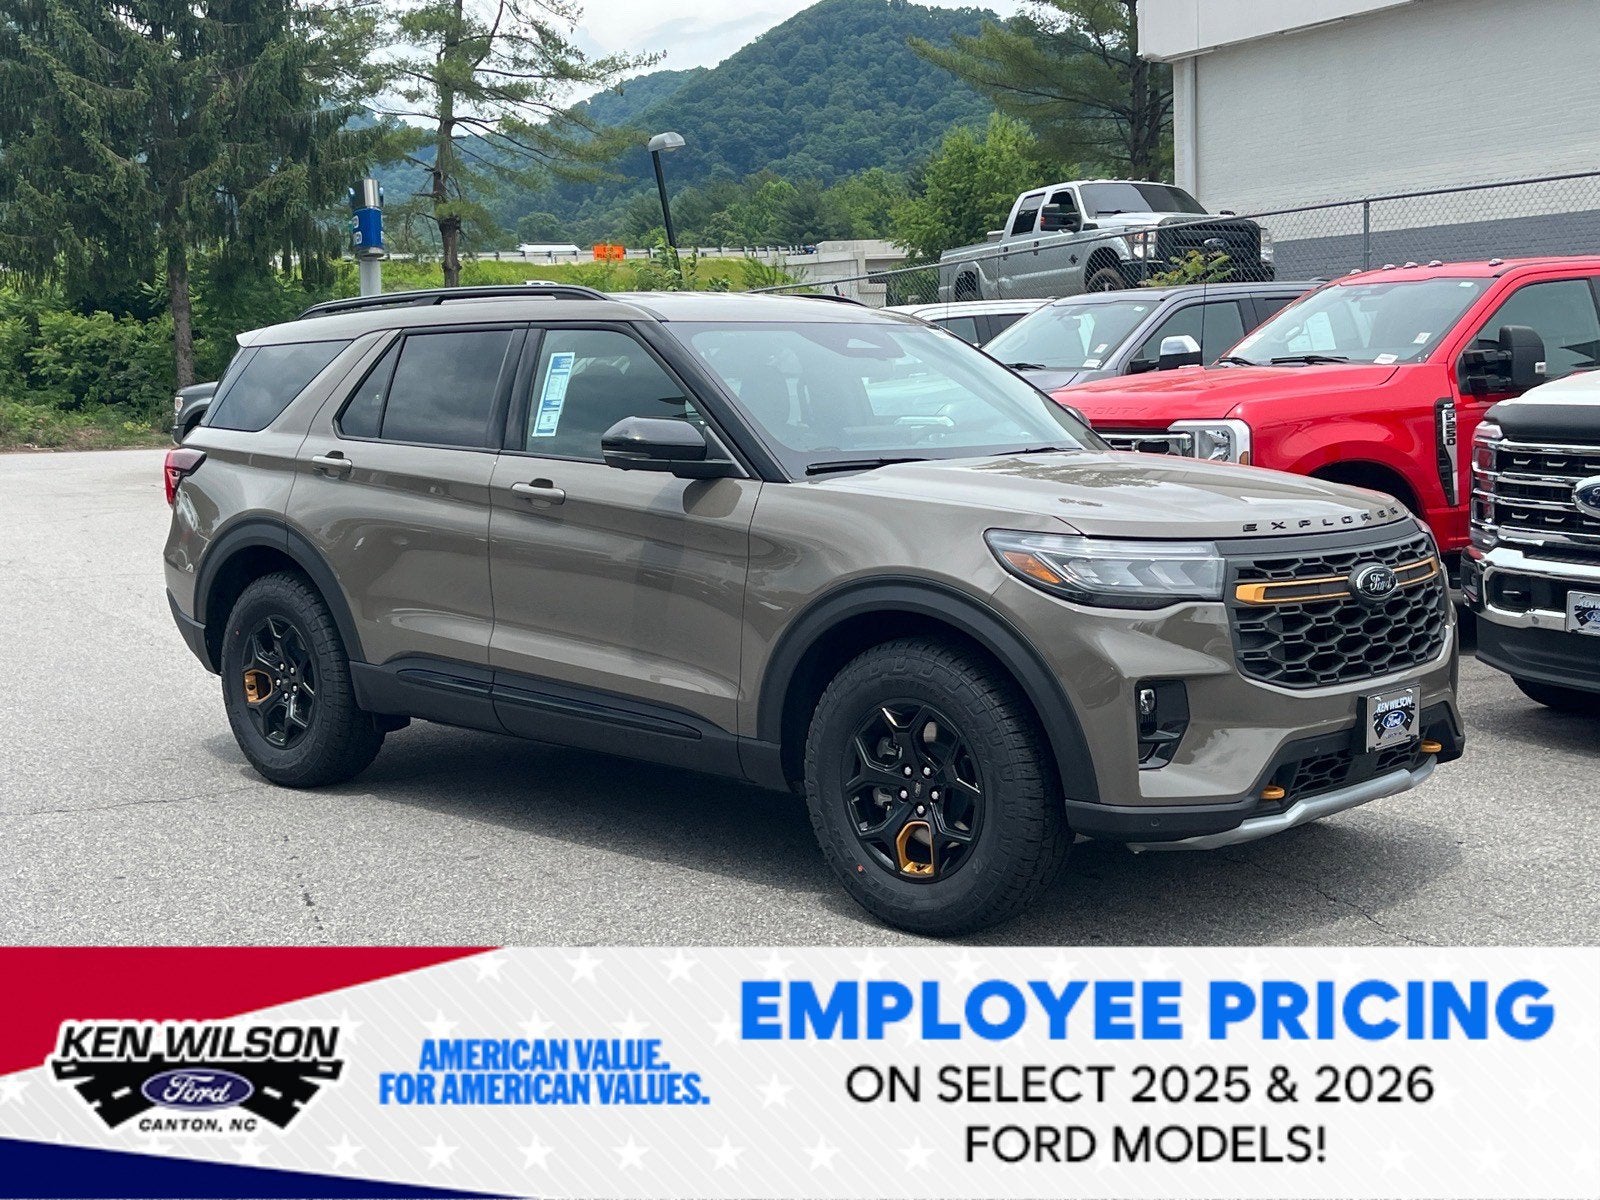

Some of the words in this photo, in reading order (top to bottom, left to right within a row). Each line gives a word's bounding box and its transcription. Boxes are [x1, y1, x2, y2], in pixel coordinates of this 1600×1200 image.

[1243, 507, 1399, 532] EXPLORER
[1370, 573, 1392, 592] Ford
[1389, 696, 1413, 710] WILSON
